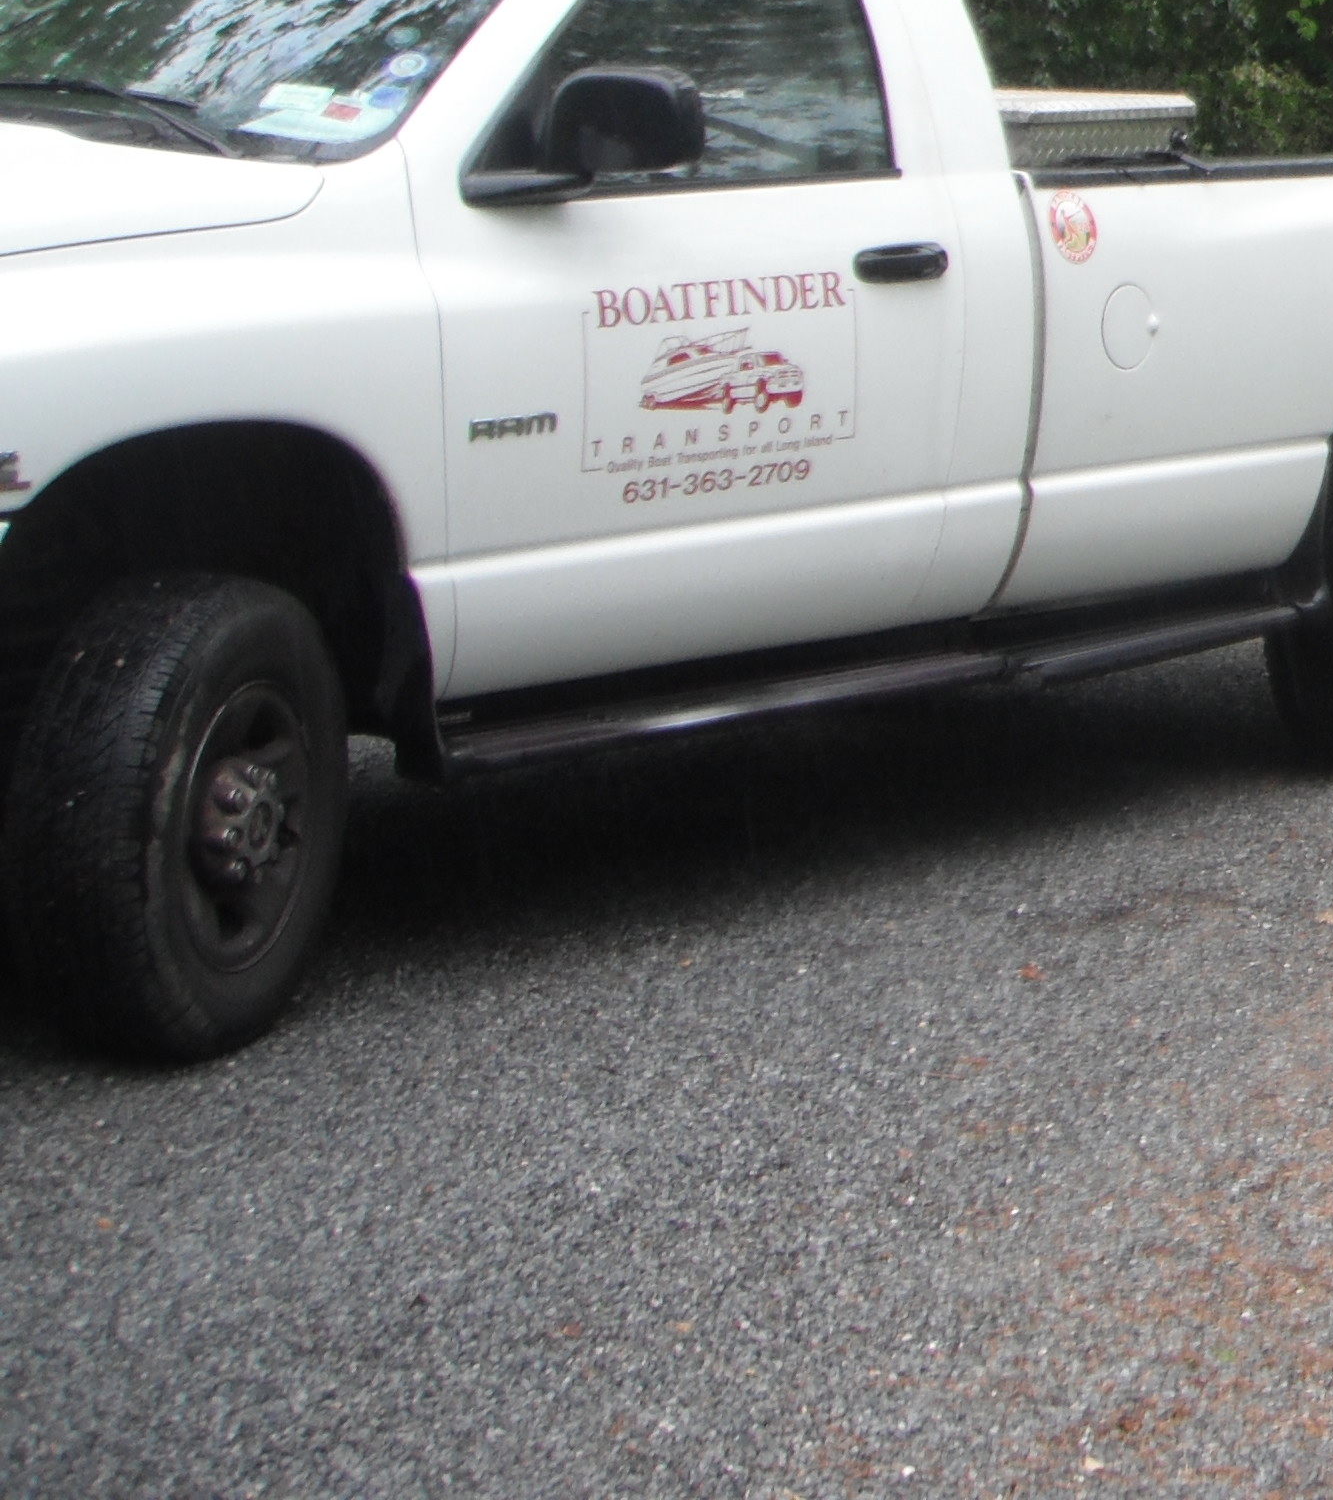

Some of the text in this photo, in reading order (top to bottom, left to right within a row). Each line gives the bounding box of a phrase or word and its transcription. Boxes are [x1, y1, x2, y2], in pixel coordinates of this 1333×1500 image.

[592, 270, 846, 330] BOATFINDER
[468, 411, 558, 443] RAM
[590, 409, 849, 459] TRANSPORT
[622, 458, 812, 504] 631-363-2709
